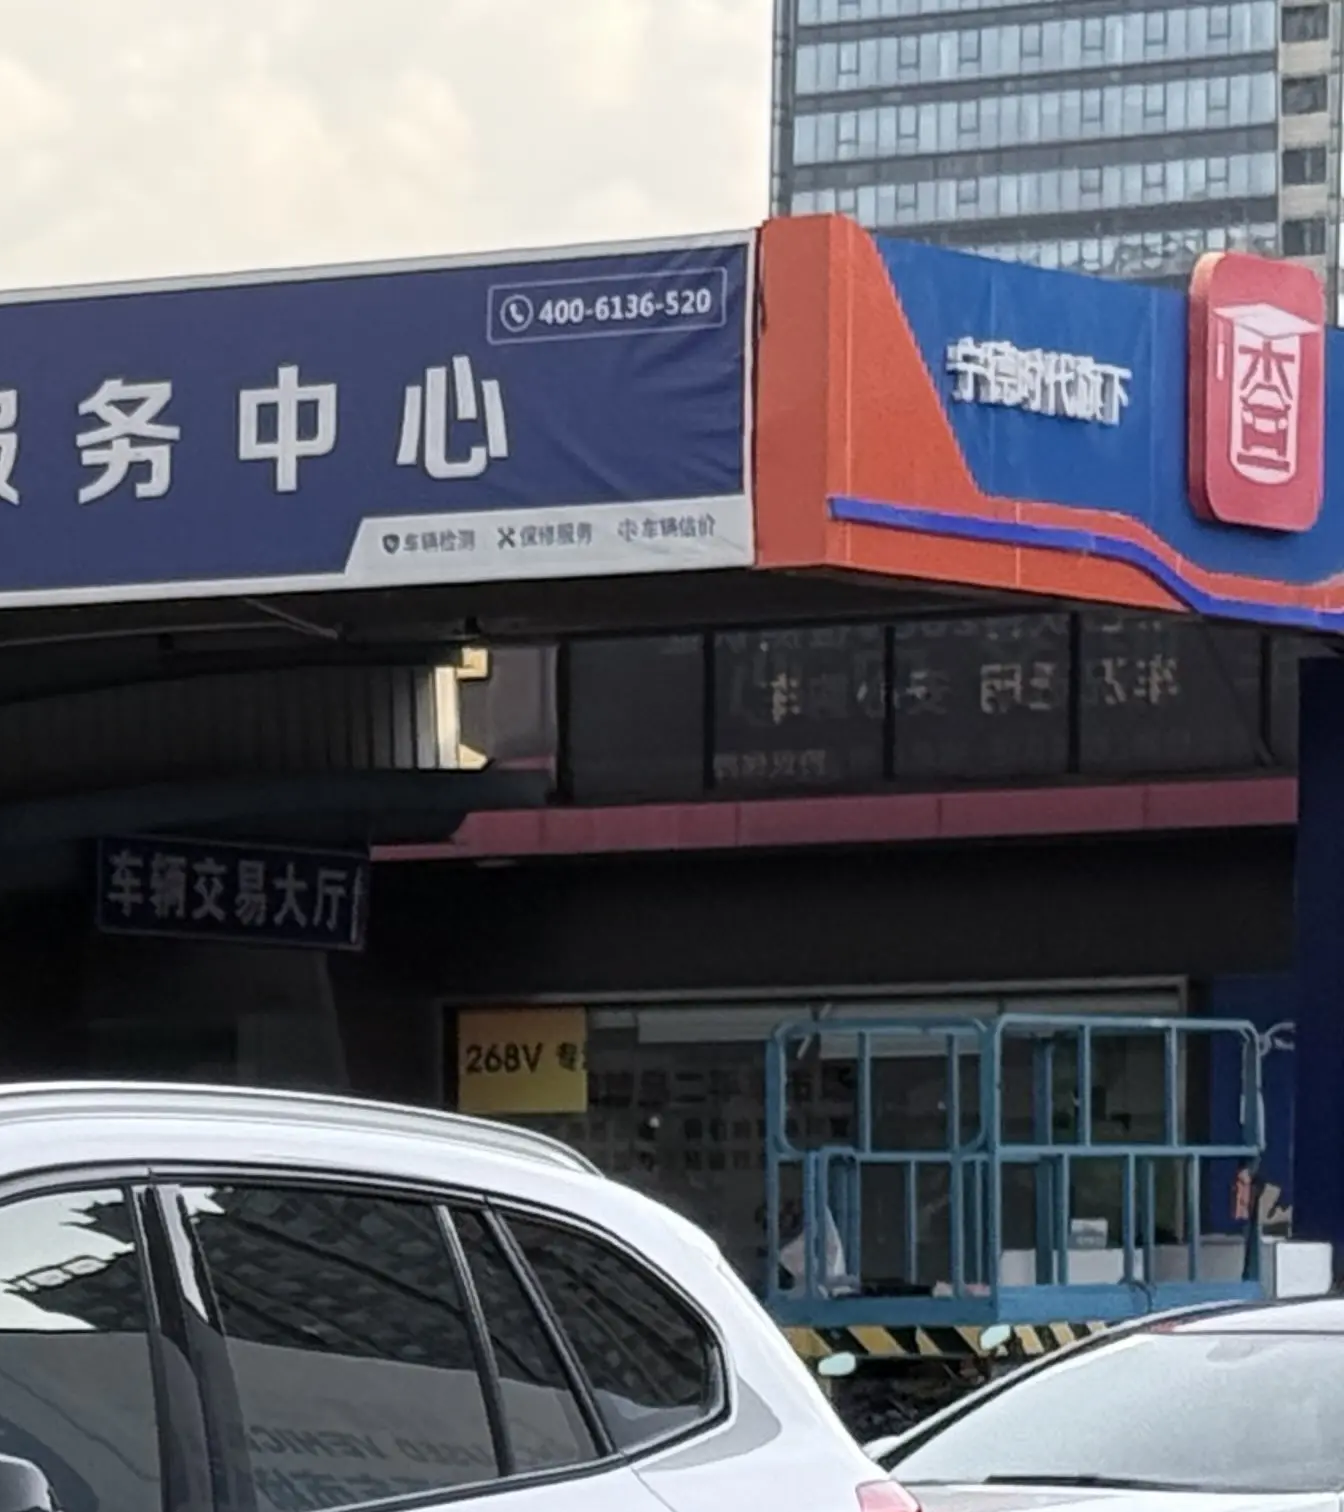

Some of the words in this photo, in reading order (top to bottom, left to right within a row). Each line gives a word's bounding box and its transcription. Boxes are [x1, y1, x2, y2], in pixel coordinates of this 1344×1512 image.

[538, 288, 711, 325] 400-6136-520
[640, 513, 716, 539] 车辆估价
[107, 849, 348, 932] 车辆交易大厅
